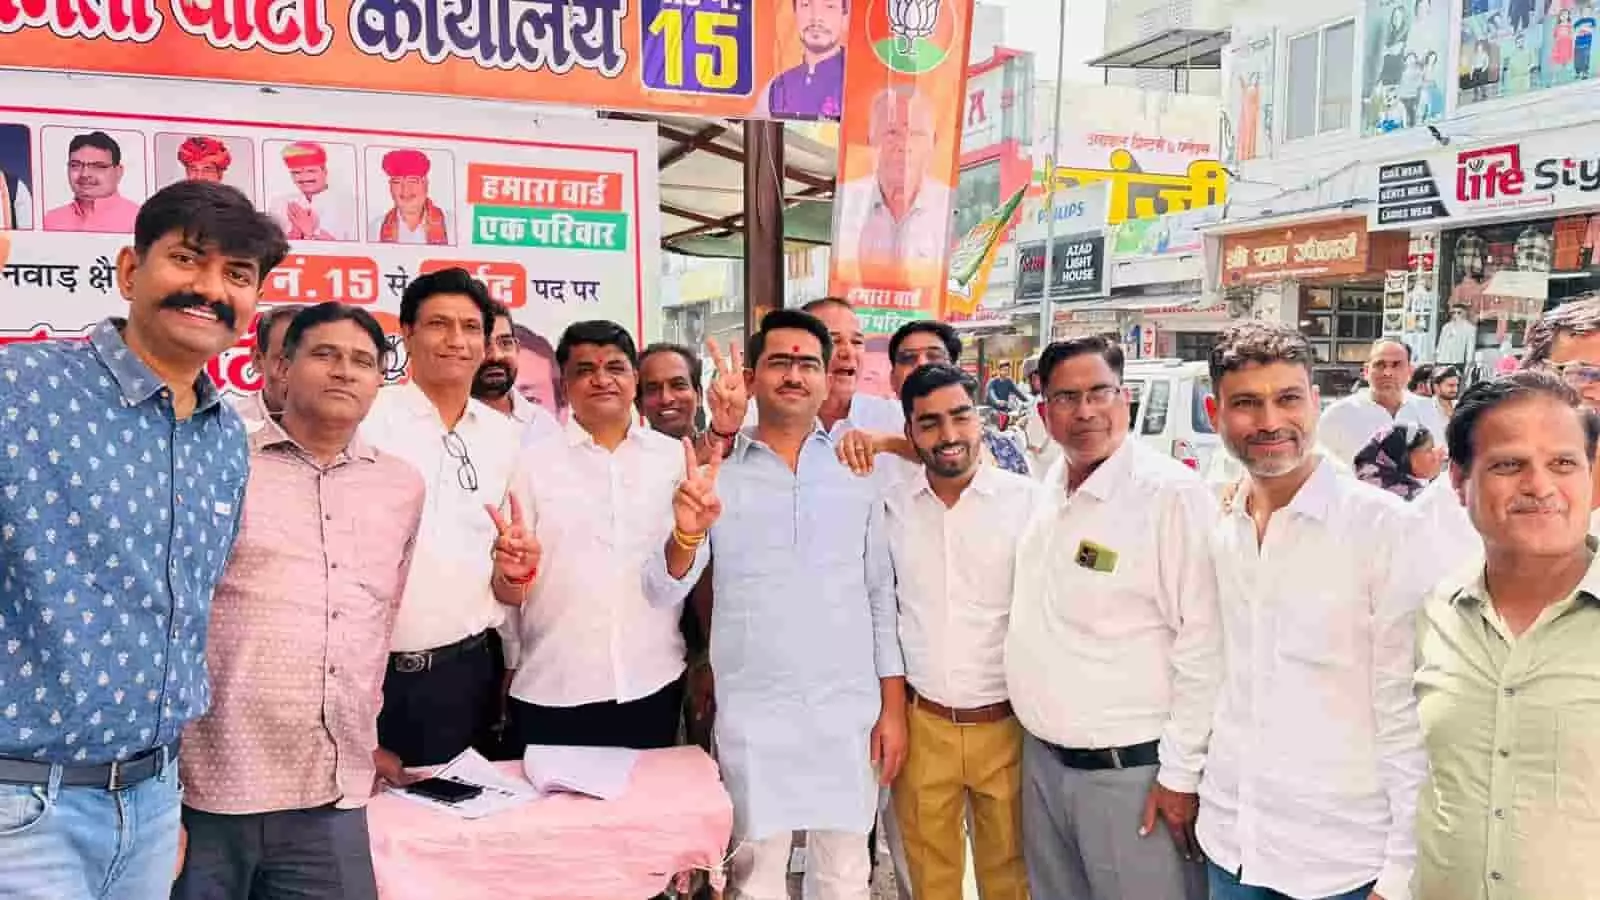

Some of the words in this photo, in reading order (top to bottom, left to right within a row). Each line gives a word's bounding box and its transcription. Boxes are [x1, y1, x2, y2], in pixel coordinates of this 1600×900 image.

[648, 9, 740, 90] 15
[480, 175, 559, 203] हमारा
[562, 175, 609, 206] वार्ड
[1456, 156, 1525, 202] life
[1037, 200, 1085, 225] PILIPS
[478, 215, 527, 241] एक
[531, 212, 617, 246] परिवार
[2, 264, 80, 293] नवाड़
[324, 267, 372, 298] 15
[1062, 268, 1096, 281] HOUSE
[532, 279, 566, 302] पद
[570, 280, 601, 302] पर
